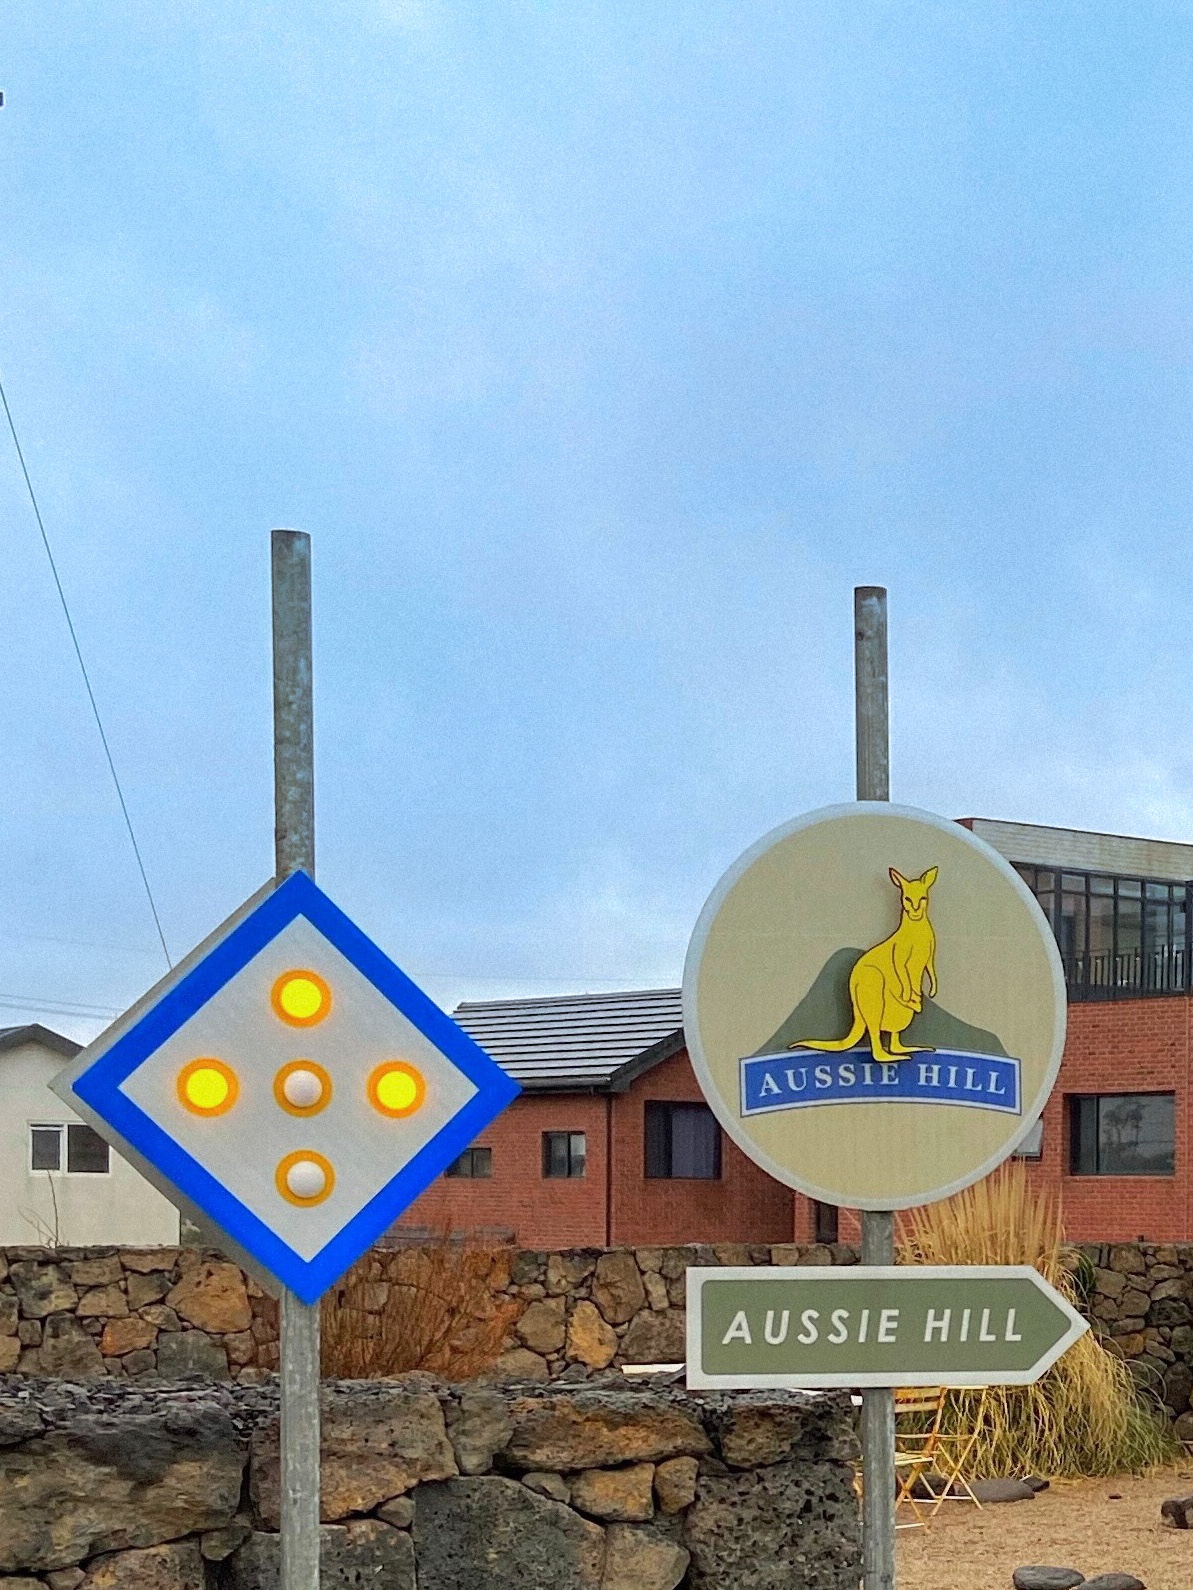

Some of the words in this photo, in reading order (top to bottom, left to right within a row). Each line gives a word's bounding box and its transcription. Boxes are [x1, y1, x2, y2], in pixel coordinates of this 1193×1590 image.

[758, 1063, 899, 1098] AUSSIE
[917, 1063, 1006, 1095] HILL
[721, 1308, 900, 1345] AUSSIE
[924, 1307, 1022, 1342] HILL
